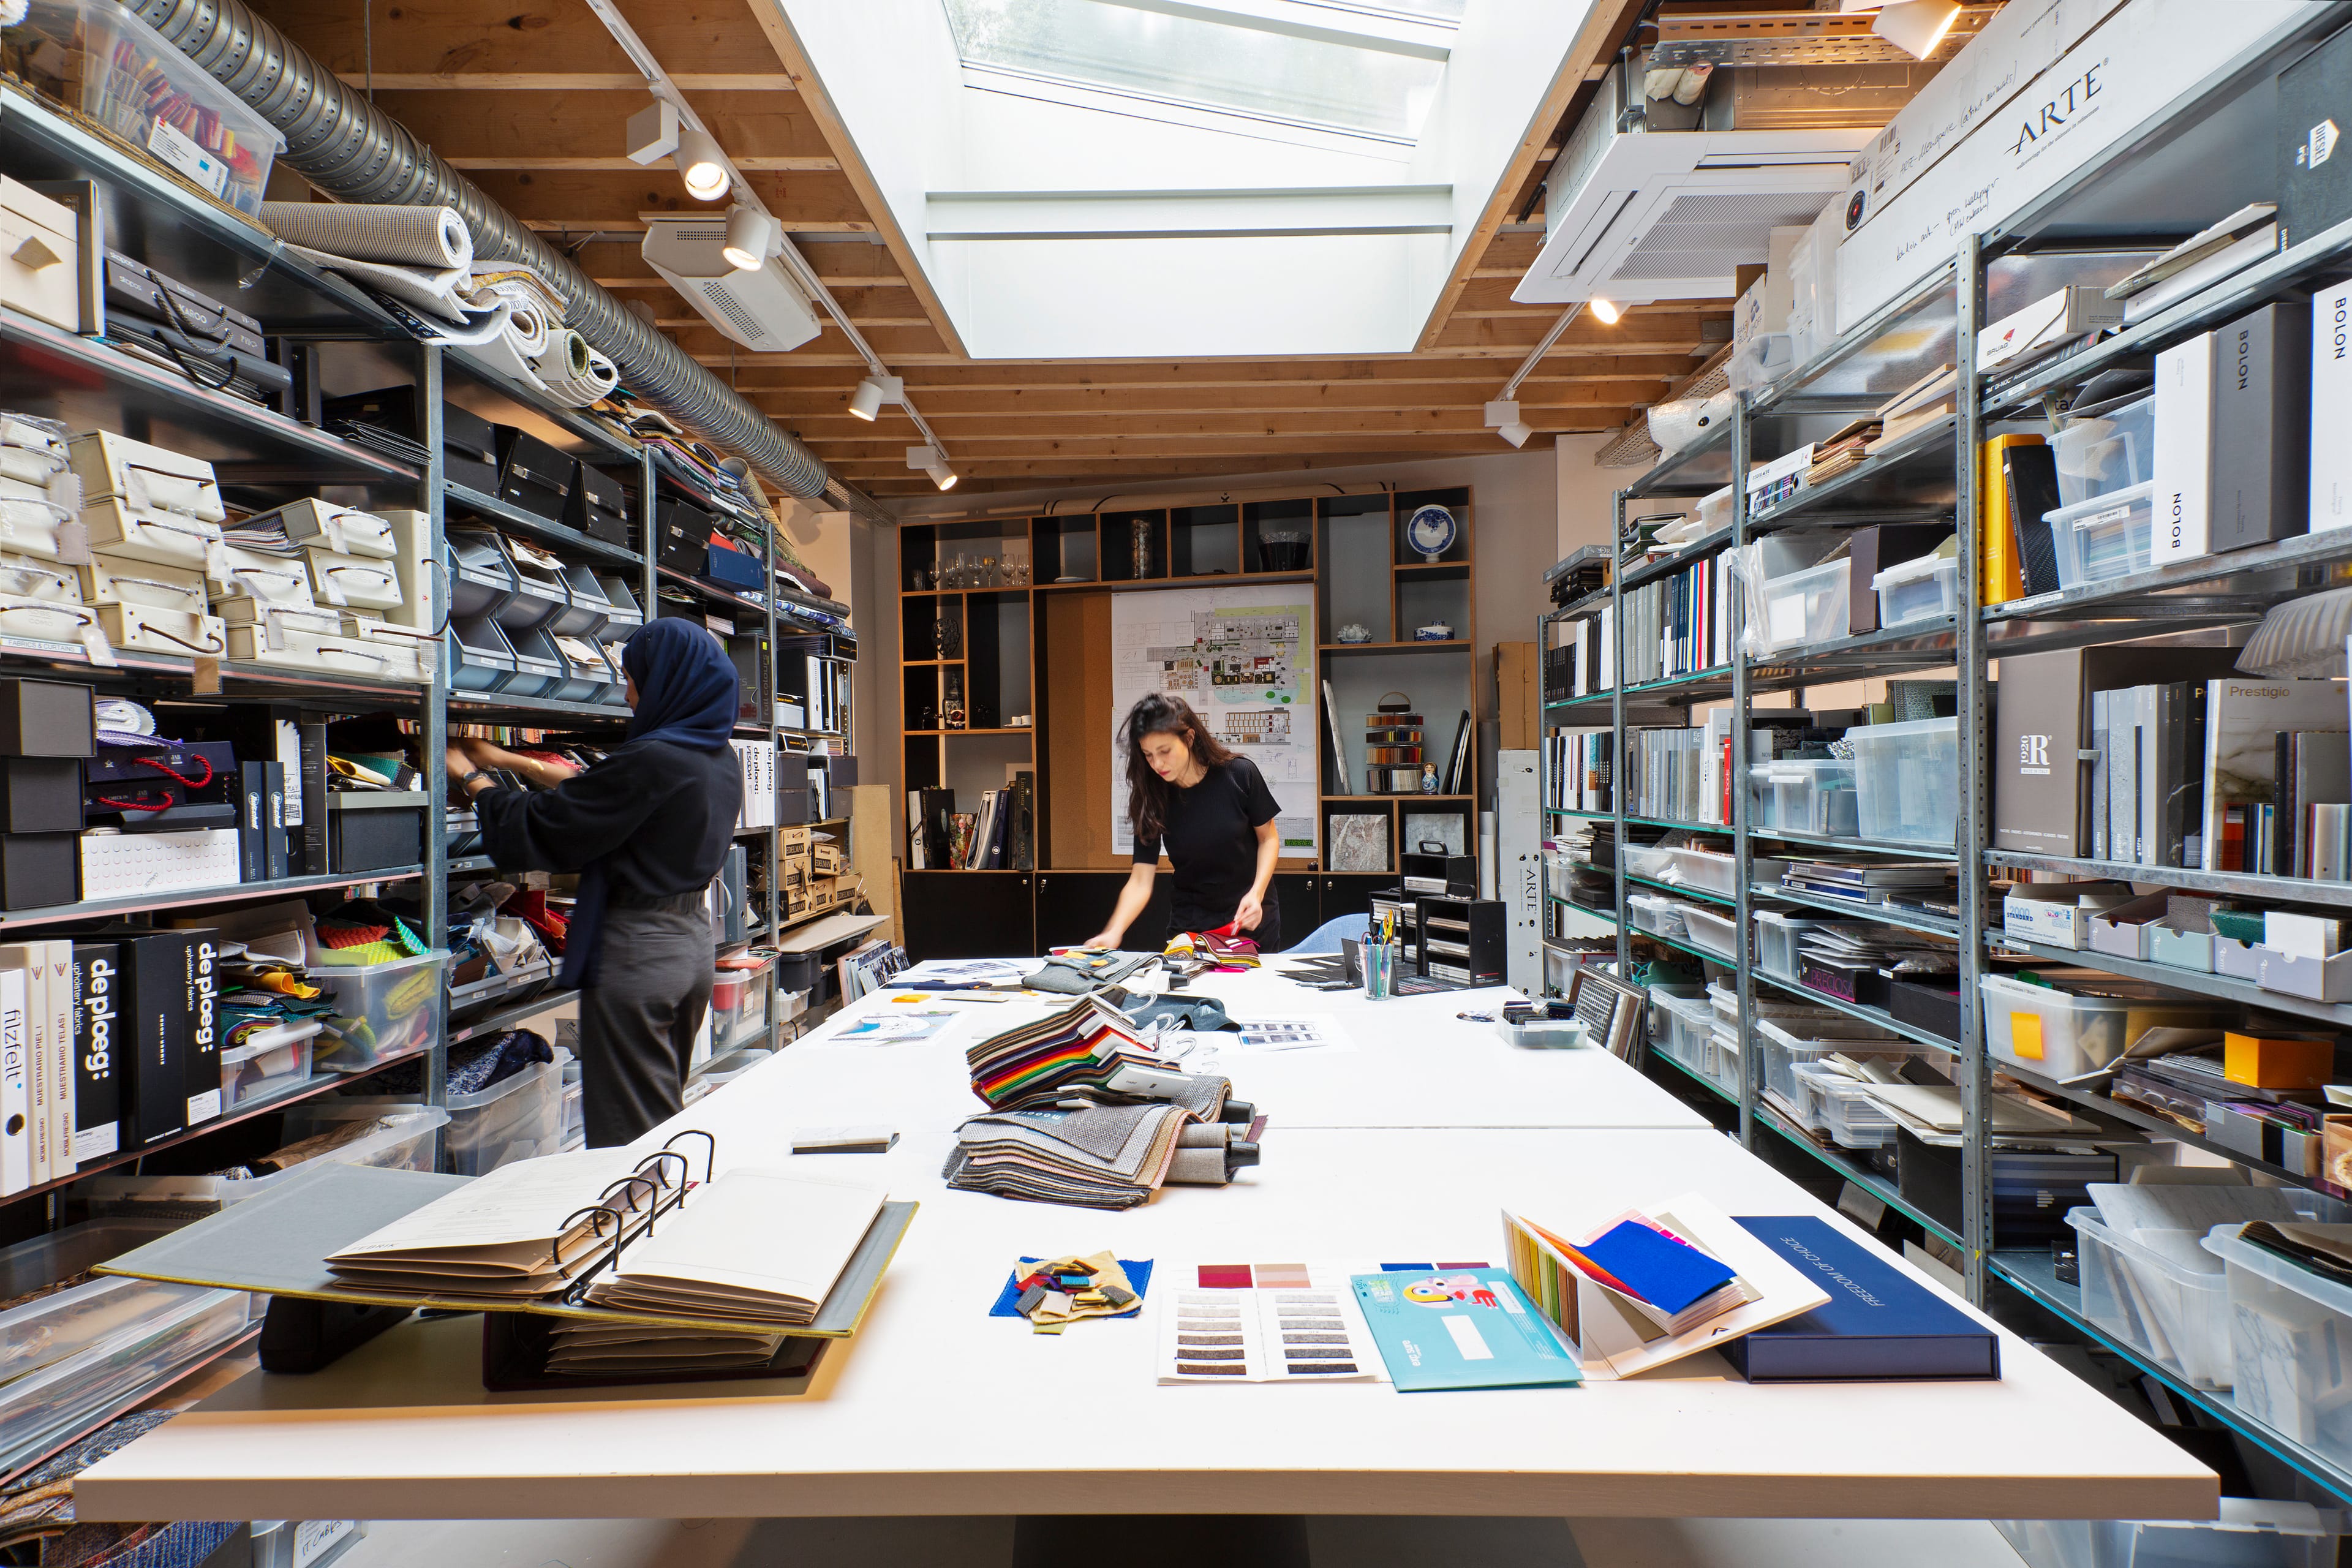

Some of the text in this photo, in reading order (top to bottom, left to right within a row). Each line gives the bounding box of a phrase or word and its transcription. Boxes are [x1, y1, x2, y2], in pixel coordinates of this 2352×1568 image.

[178, 303, 208, 325] KAROO
[2334, 296, 2347, 360] BOLON
[2237, 329, 2249, 391] BOLON
[2172, 492, 2182, 549] BOLON
[7, 639, 36, 647] FABRICS
[43, 643, 75, 652] CURTAINS
[2229, 685, 2290, 699] Prestigio
[2020, 735, 2029, 764] 1920
[786, 845, 804, 854] EDELMAN
[815, 859, 831, 868] EDELMAN
[837, 888, 855, 898] EDELMAN
[2007, 912, 2034, 922] STANDARD
[1811, 968, 1855, 998] PRECIOSA
[4, 1008, 22, 1082] filzfelt
[1779, 1237, 1820, 1261] CHOICE
[1827, 1272, 1886, 1306] FREEDOM
[303, 1539, 311, 1556] IT
